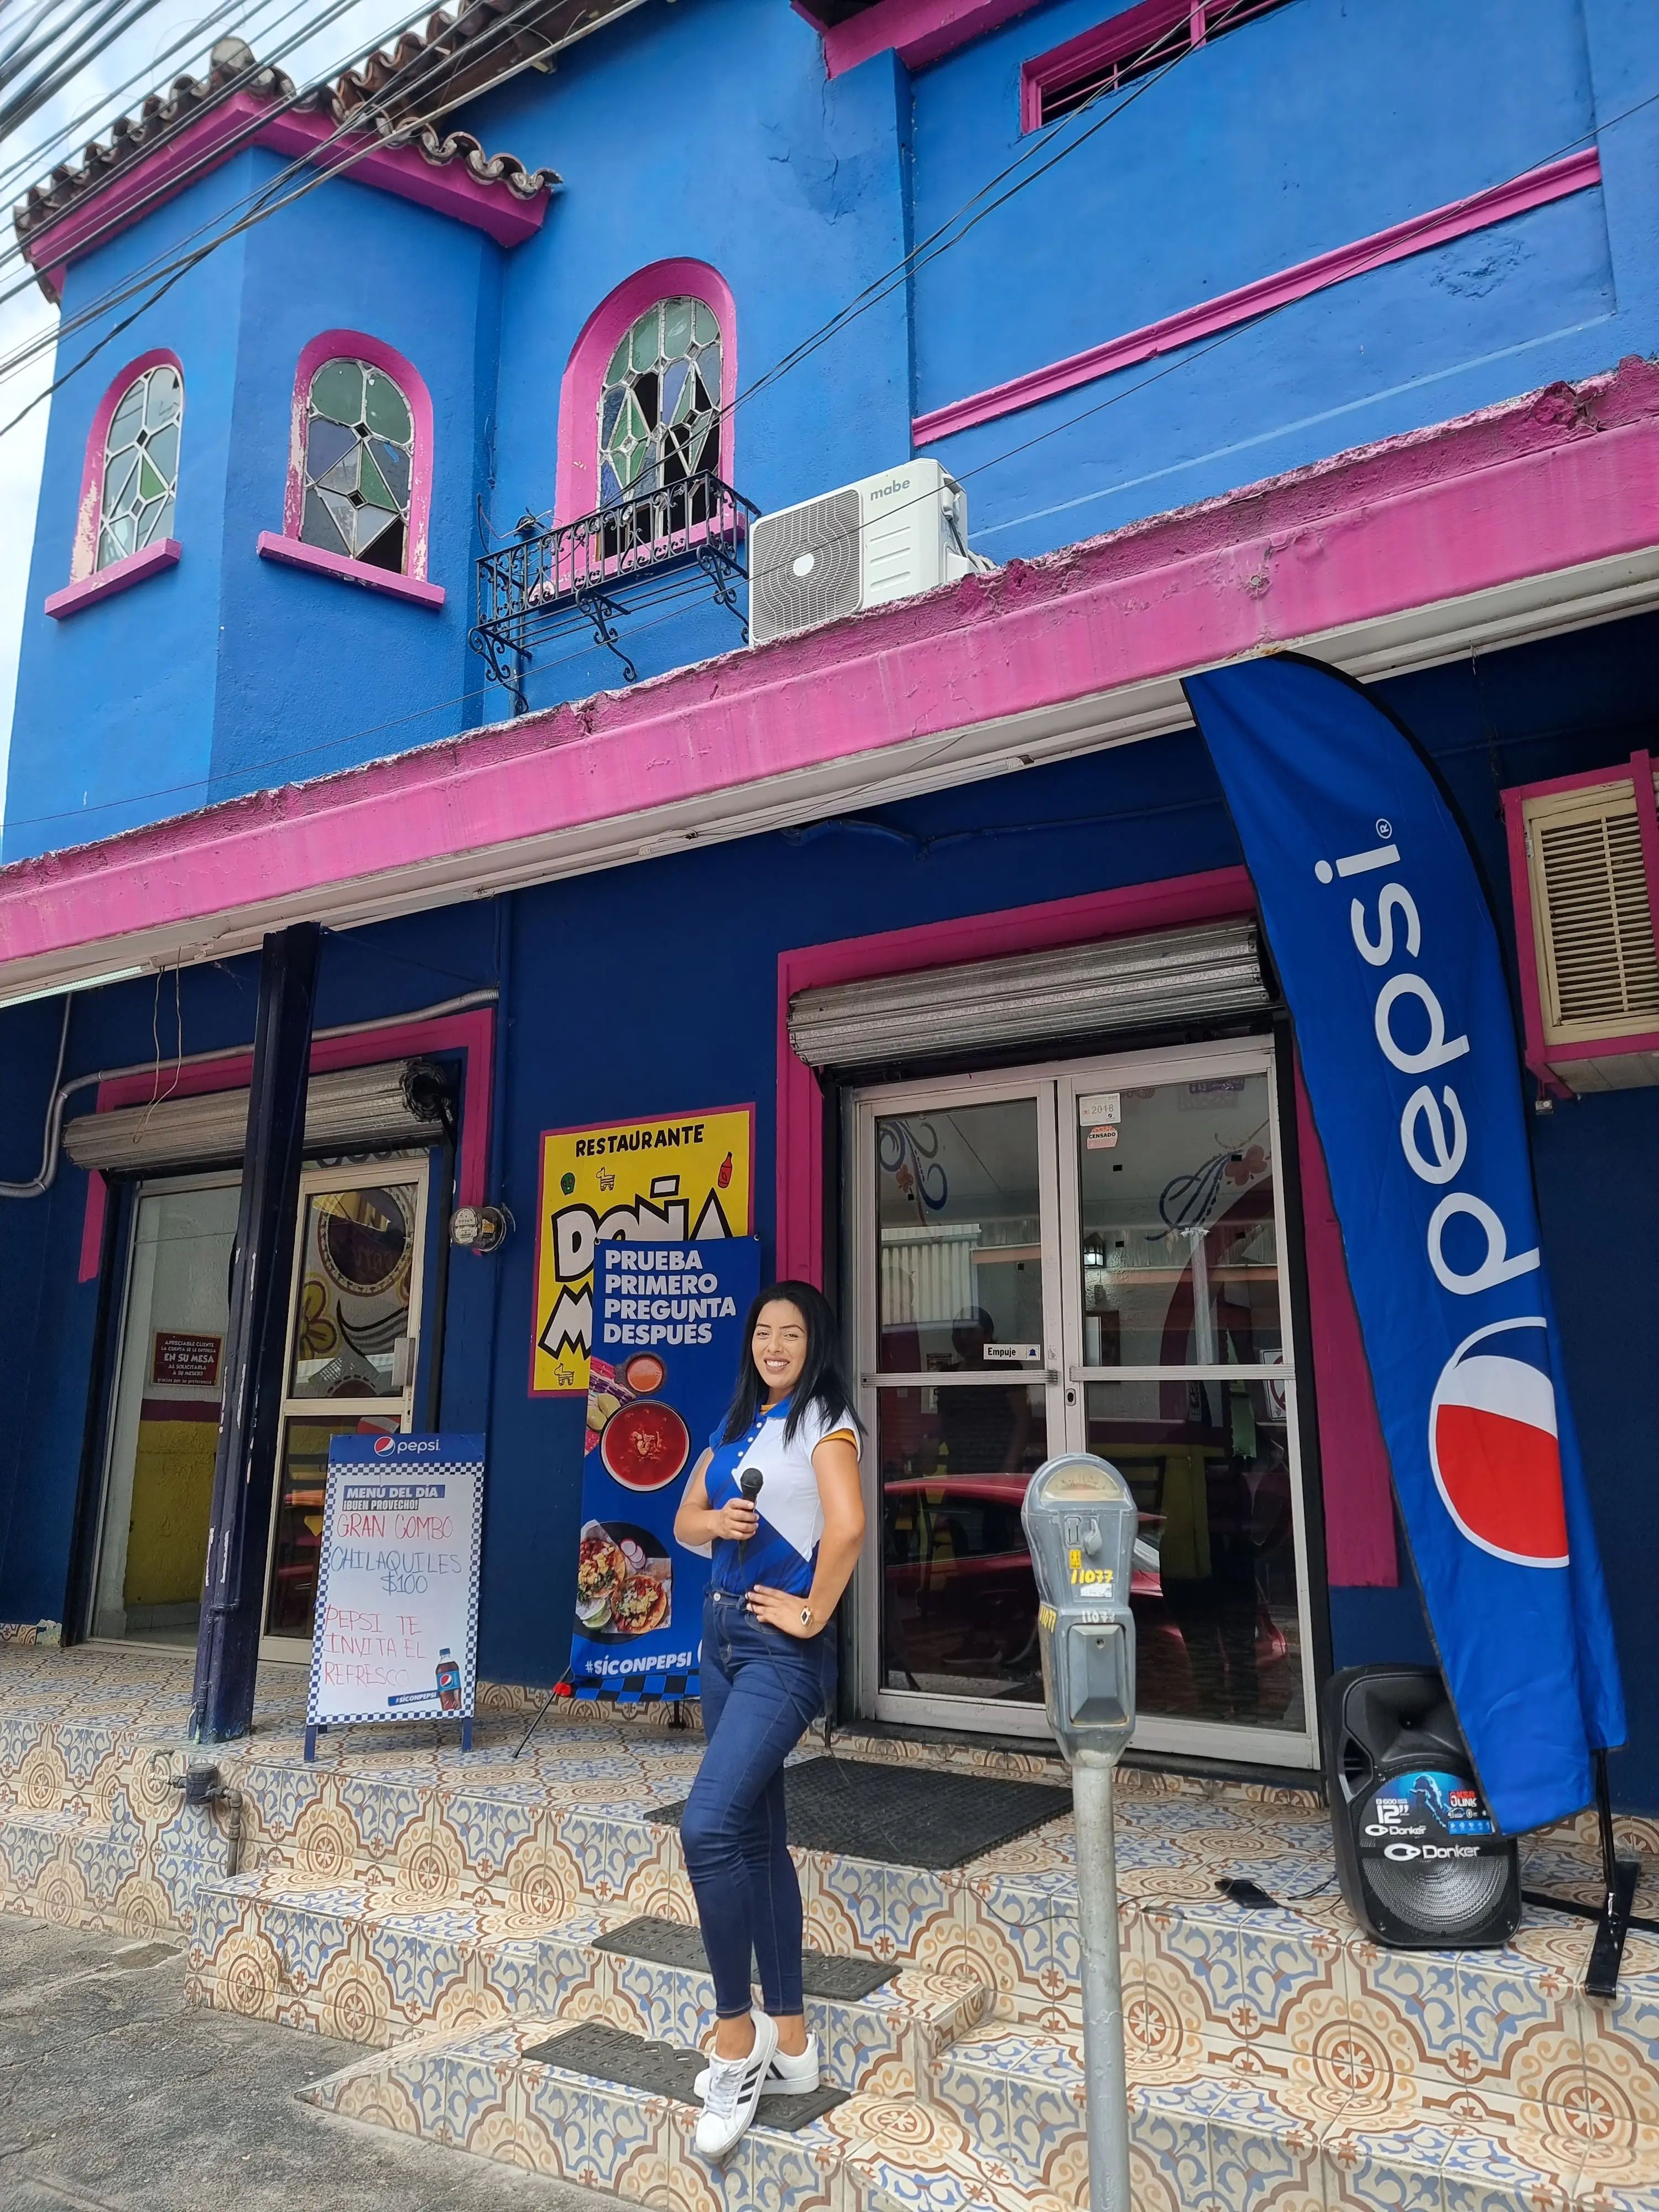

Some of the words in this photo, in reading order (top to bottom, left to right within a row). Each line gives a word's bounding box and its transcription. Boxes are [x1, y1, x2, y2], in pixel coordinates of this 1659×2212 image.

[870, 479, 910, 501] mabe
[1315, 844, 1540, 1295] pepsi
[1091, 1104, 1114, 1114] 2018
[575, 1124, 705, 1157] RESTAURANTE
[606, 1250, 703, 1271] PRUEBA
[605, 1273, 718, 1295] PRIMERO
[604, 1296, 736, 1320] PREGUNTA
[604, 1318, 712, 1345] DESPUÉS
[164, 1353, 176, 1362] EN
[178, 1354, 189, 1363] SU
[191, 1355, 215, 1364] MESA
[988, 1347, 1016, 1357] Empuje
[397, 1439, 440, 1454] pepsi
[347, 1485, 387, 1499] MENÚ
[389, 1487, 413, 1498] DEL
[415, 1484, 439, 1498] DÍA
[343, 1499, 369, 1511] ¡BUEN
[371, 1499, 419, 1510] PROVECHO!
[337, 1512, 385, 1537] GRAN
[394, 1514, 453, 1540] COMBO
[331, 1546, 462, 1576] CHILAQUILES
[380, 1572, 428, 1597] $100
[1071, 1569, 1114, 1585] 11077
[325, 1604, 383, 1632] PEPSI
[395, 1616, 422, 1635] TE
[323, 1632, 397, 1658] INVITA
[404, 1639, 427, 1659] EL
[325, 1661, 409, 1688] REFRESCO
[585, 1651, 692, 1676] #SÍCONPEPSI
[1389, 1825, 1427, 1835] Donker
[1422, 1843, 1481, 1859] Donker
